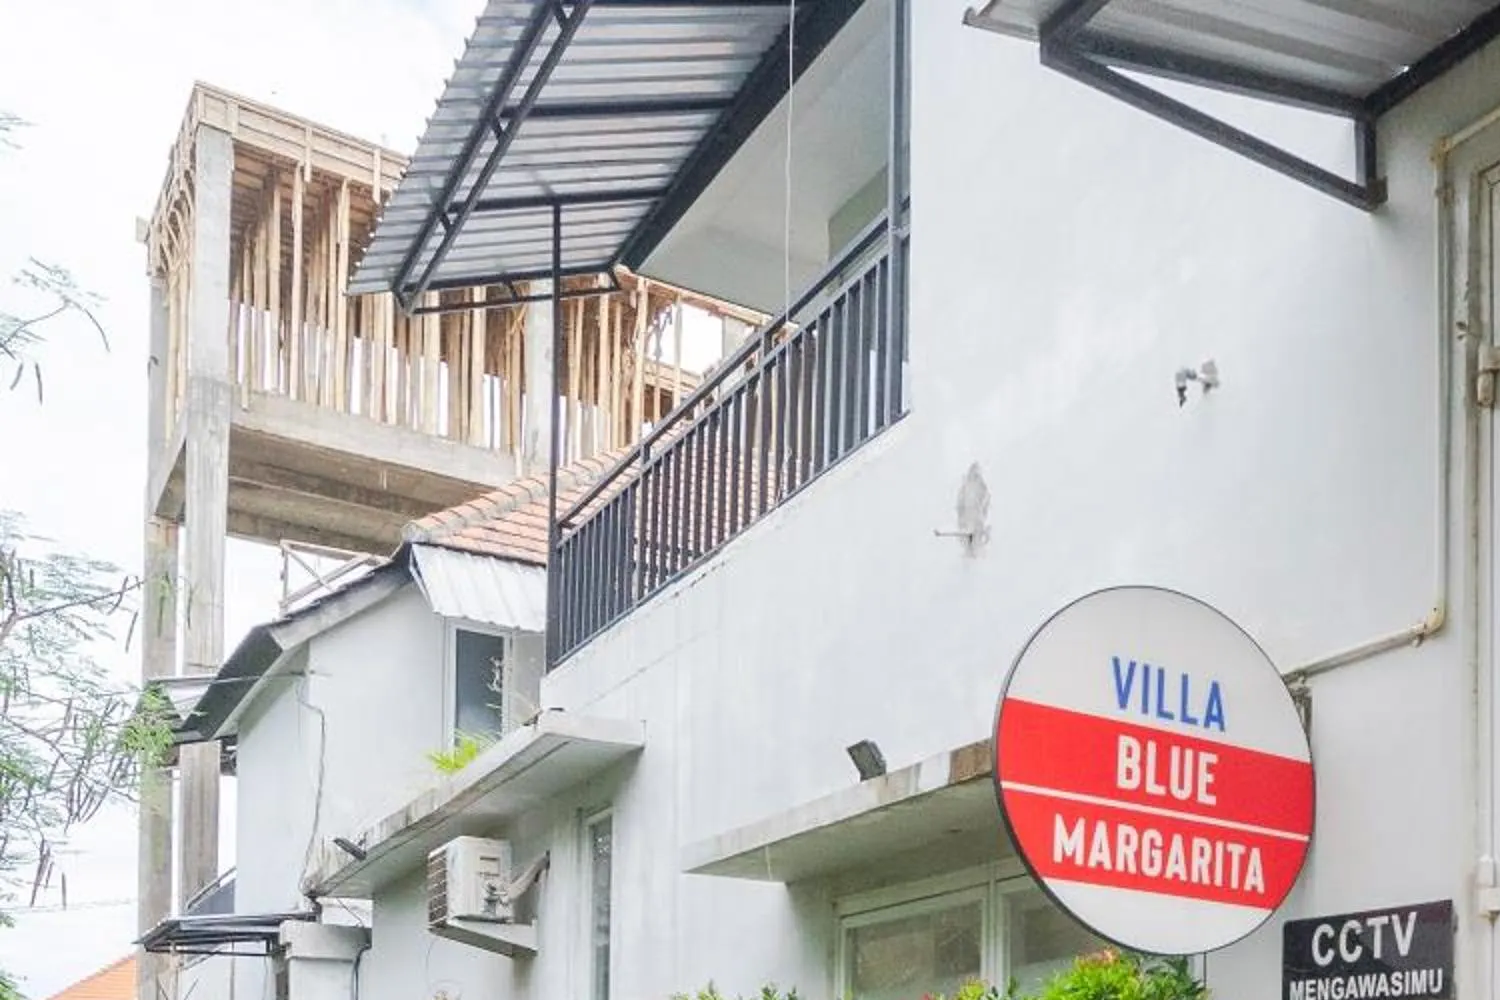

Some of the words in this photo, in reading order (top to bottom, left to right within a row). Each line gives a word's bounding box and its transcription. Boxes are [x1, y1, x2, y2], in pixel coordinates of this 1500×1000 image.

[1111, 655, 1227, 732] VILLA
[1116, 734, 1219, 806] BLUE
[1053, 813, 1265, 894] MARGARITA
[1311, 911, 1417, 966] CCTV
